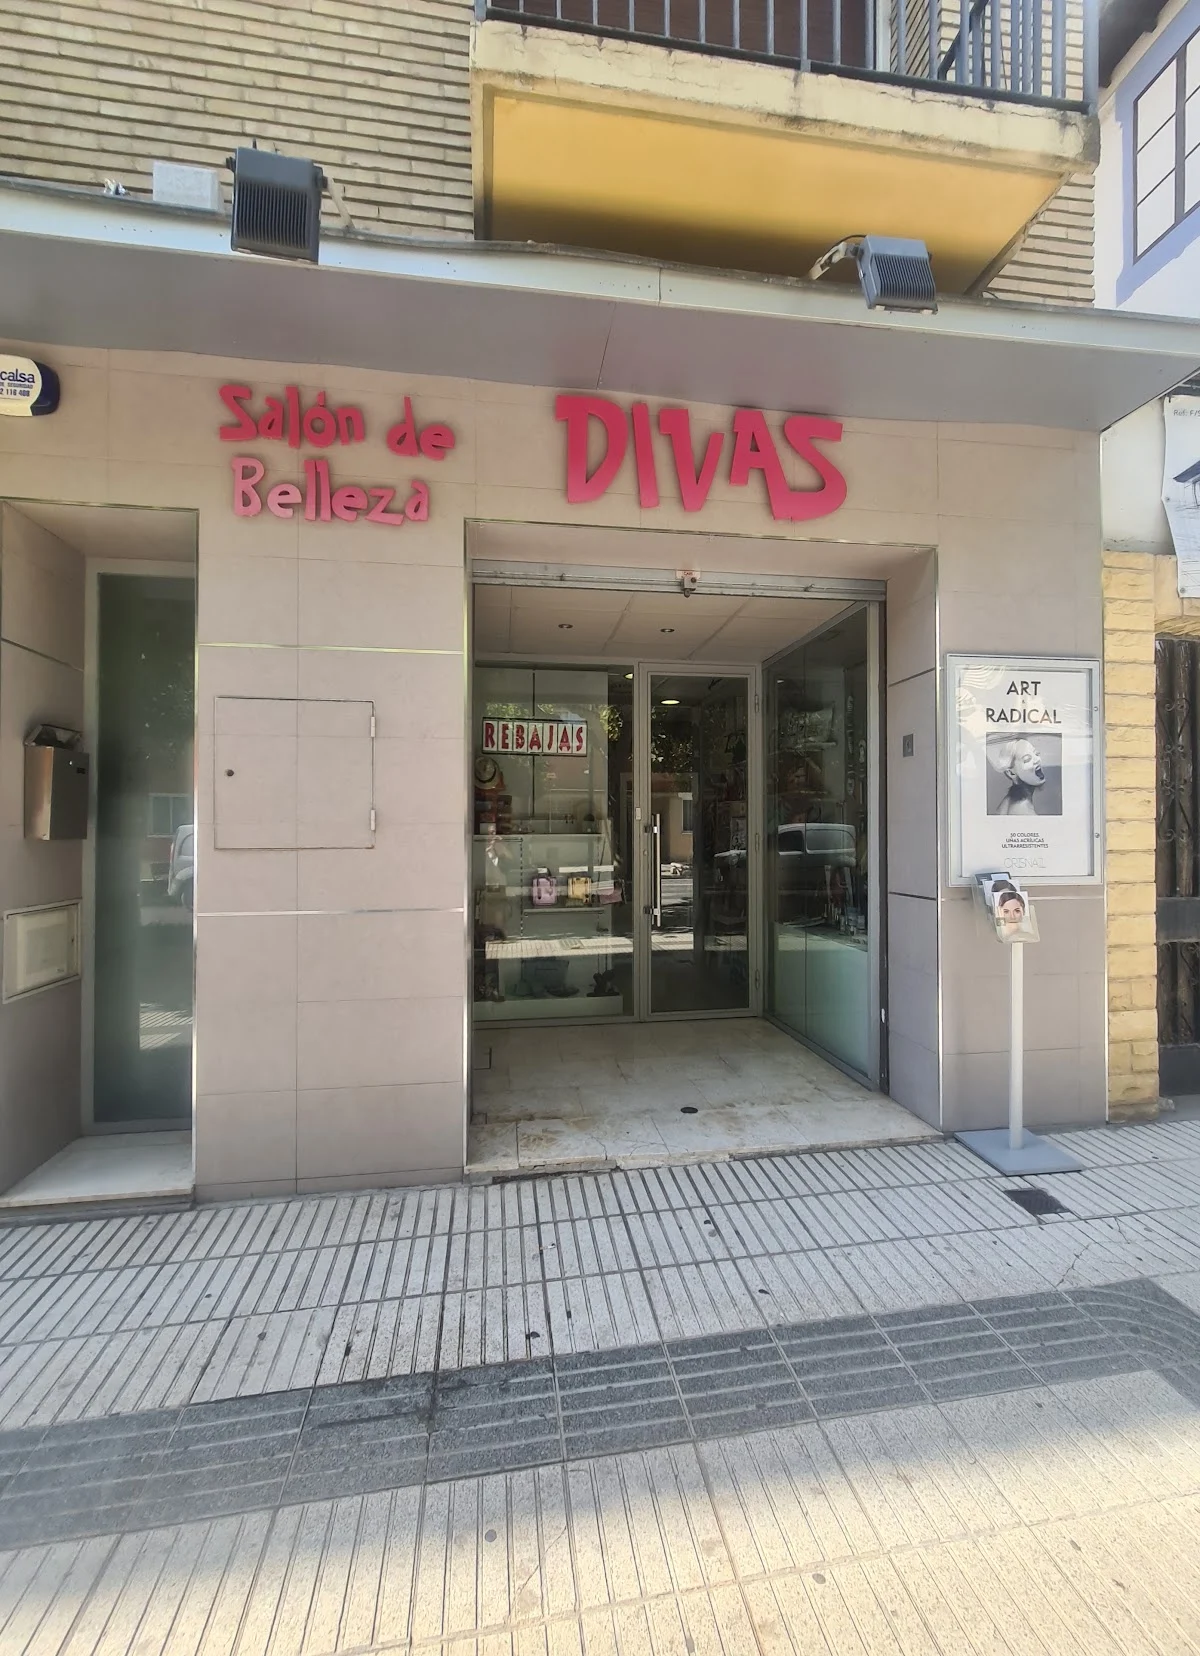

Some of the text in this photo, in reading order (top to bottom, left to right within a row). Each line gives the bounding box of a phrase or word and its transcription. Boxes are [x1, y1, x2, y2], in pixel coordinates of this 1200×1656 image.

[0, 368, 35, 384] calsa
[218, 384, 456, 460] Salón de
[555, 394, 848, 521] DIVAS
[231, 456, 430, 525] Belleza
[1006, 680, 1041, 696] ART
[985, 707, 1062, 724] RADICAL
[484, 722, 584, 752] REBAJAS
